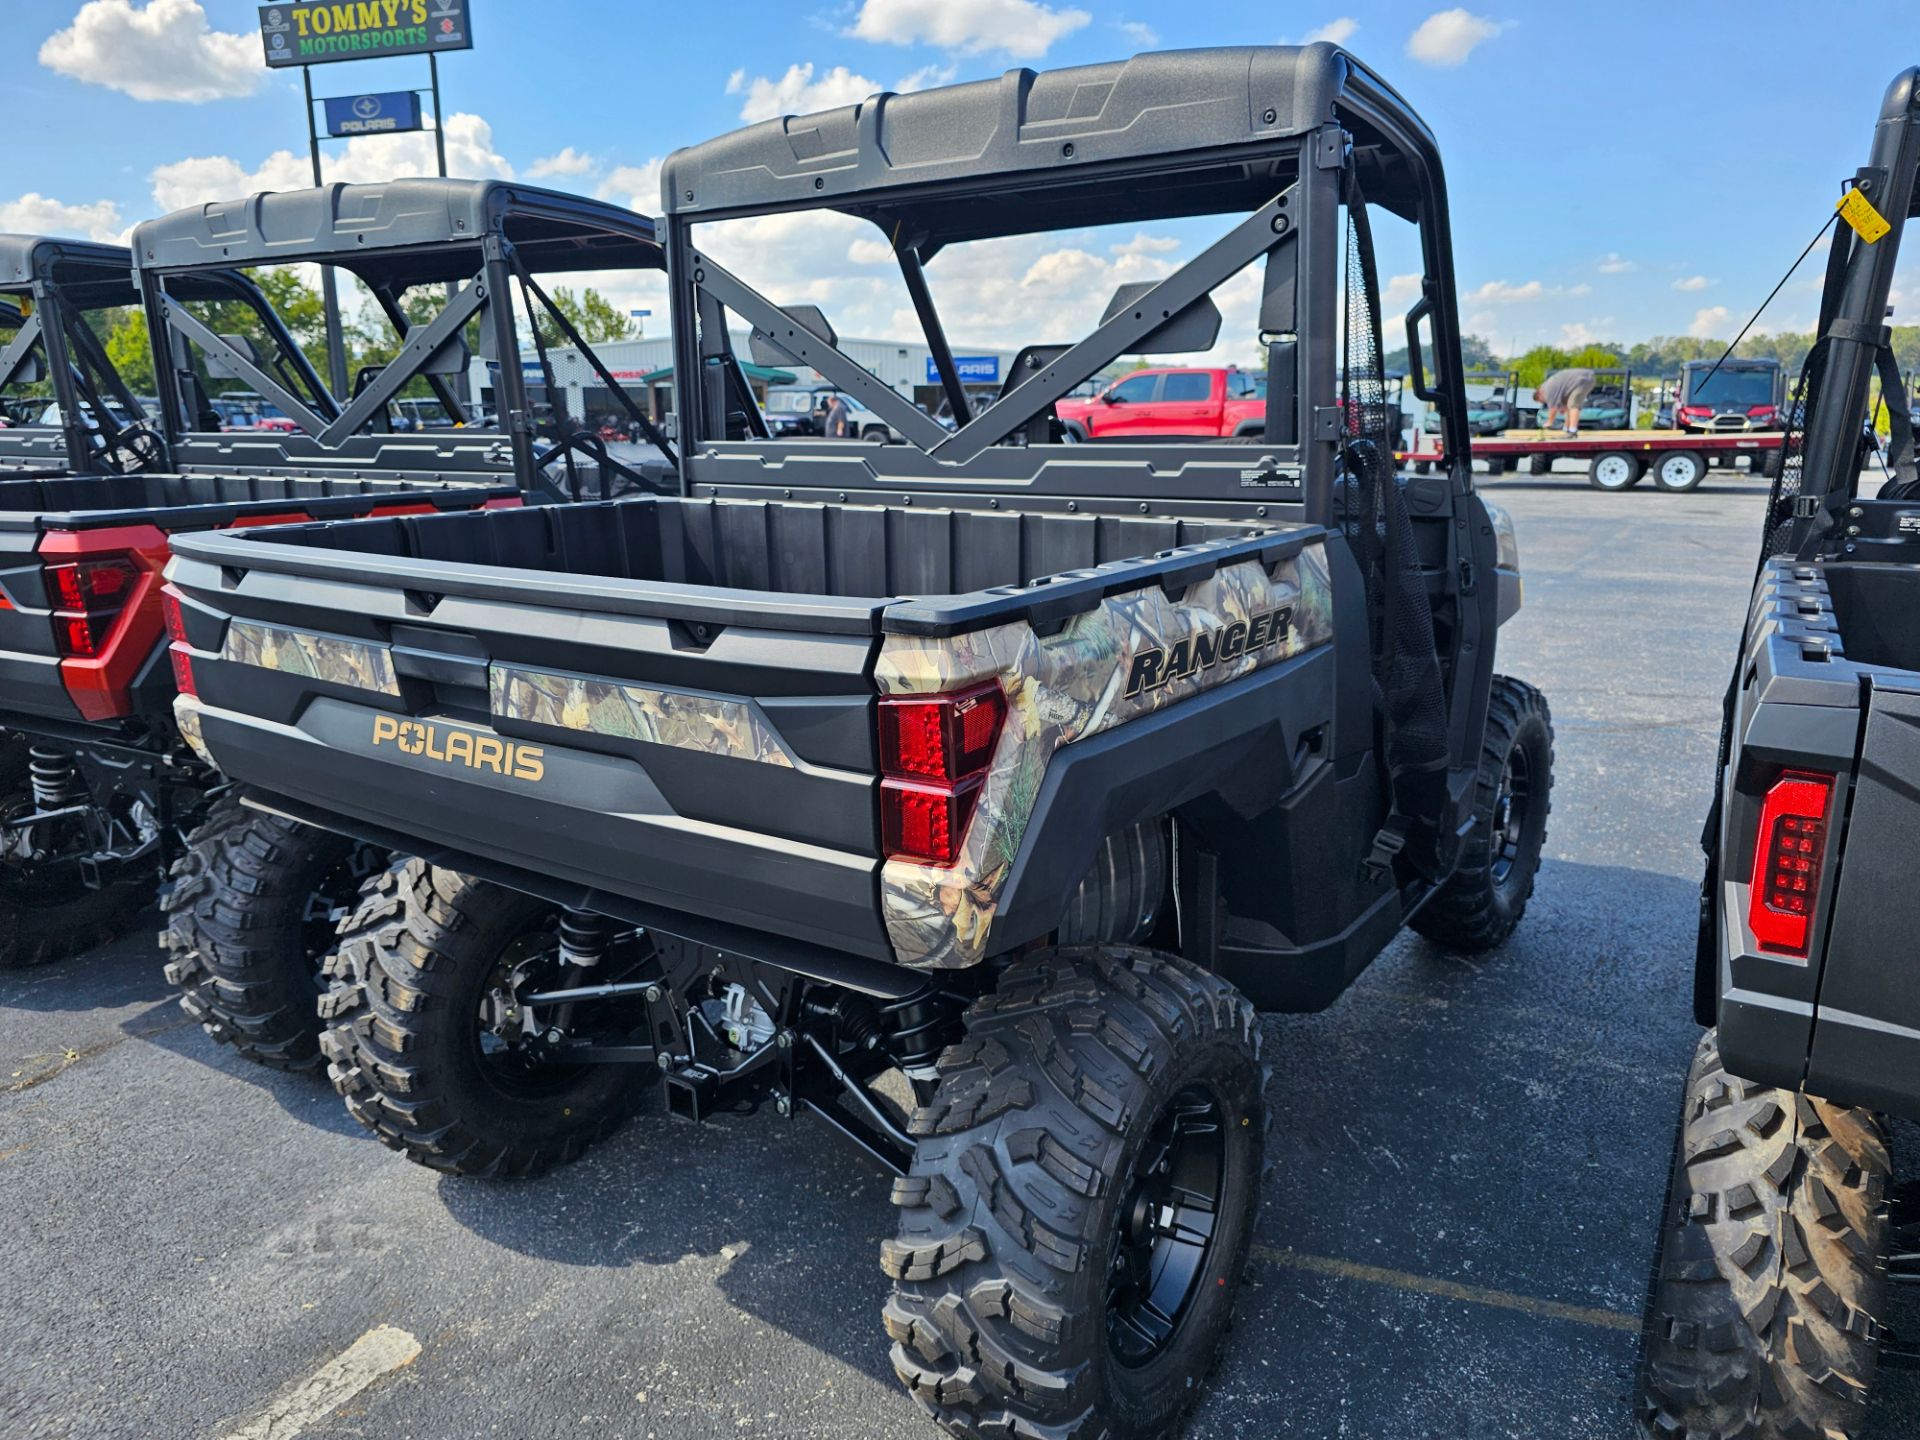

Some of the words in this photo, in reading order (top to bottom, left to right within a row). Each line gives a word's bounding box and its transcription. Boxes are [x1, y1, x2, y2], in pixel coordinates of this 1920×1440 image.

[292, 0, 428, 36] TOMMY'S
[299, 27, 428, 56] MOTORSPORTS
[340, 117, 397, 133] POLARIS
[1123, 604, 1294, 700] RANGER
[372, 714, 545, 782] POLARIS
